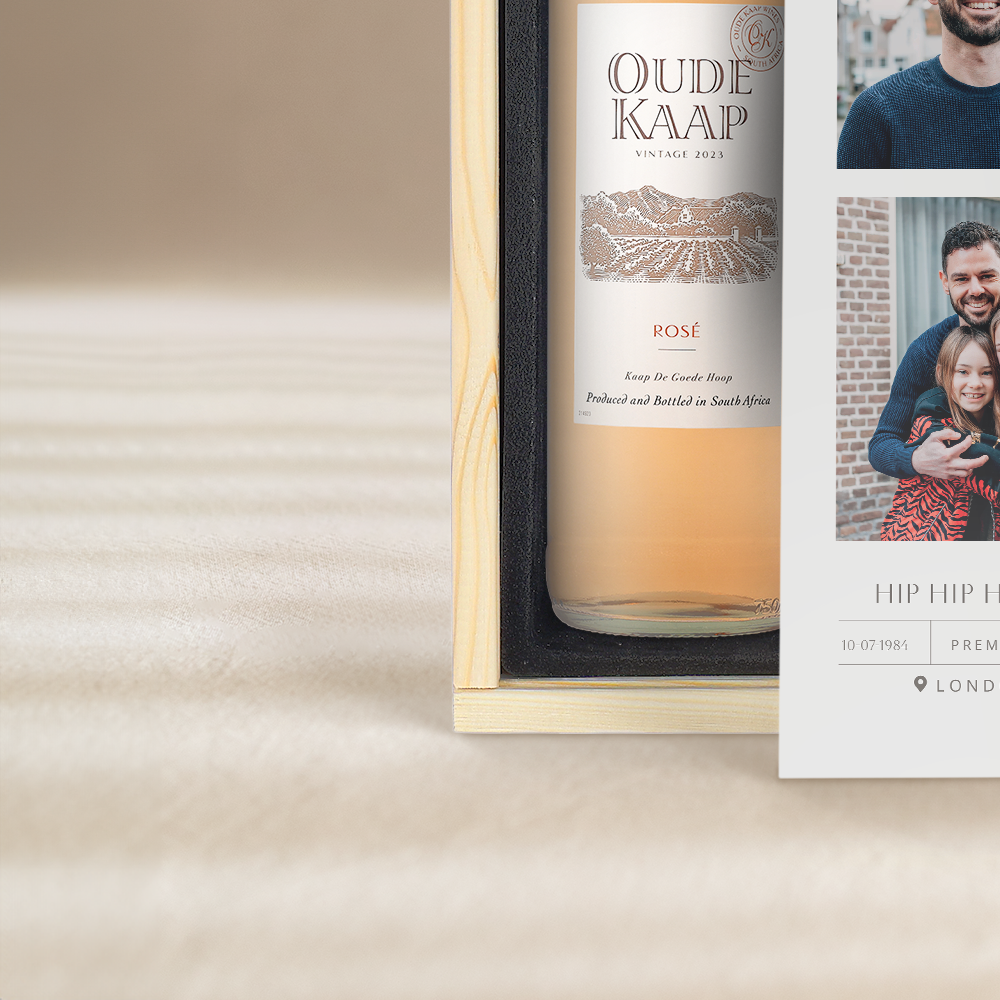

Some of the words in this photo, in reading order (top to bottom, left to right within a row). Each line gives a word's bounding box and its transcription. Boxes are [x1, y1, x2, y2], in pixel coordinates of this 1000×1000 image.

[608, 52, 753, 94] OUDE
[611, 98, 748, 140] KAAP
[635, 150, 689, 159] VINTAGE
[694, 150, 725, 159] 2023
[653, 321, 701, 338] ROSÉ
[624, 371, 651, 384] Kaap
[653, 372, 669, 382] De
[671, 372, 704, 382] Goede
[706, 372, 733, 384] Hoop
[586, 391, 628, 405] Produced
[629, 394, 651, 406] and
[653, 395, 693, 407] Bottled
[695, 395, 707, 406] in
[710, 395, 741, 407] South
[742, 394, 771, 408] Africa
[875, 583, 920, 603] HIP
[930, 583, 974, 603] HIP
[841, 639, 909, 651] 10-07-1984
